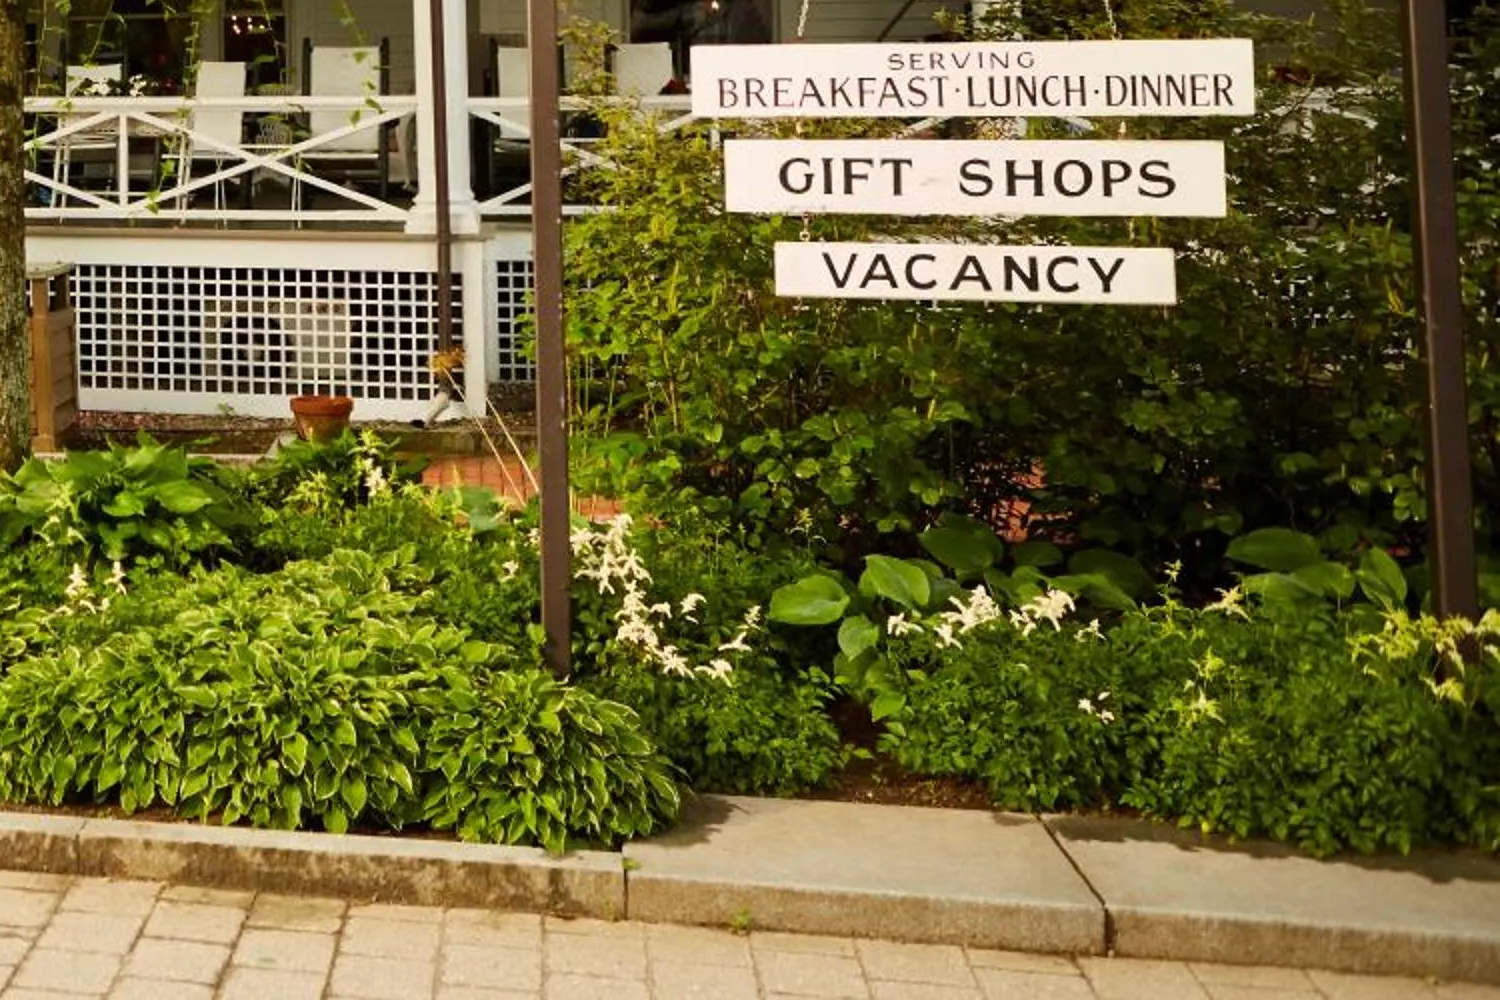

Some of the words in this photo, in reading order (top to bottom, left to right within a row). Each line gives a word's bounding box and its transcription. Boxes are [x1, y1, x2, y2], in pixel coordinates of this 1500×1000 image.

[888, 51, 1036, 71] SERVING
[779, 157, 913, 196] GIFT
[958, 159, 1177, 198] SHOPS
[822, 252, 1125, 293] VACANCY
